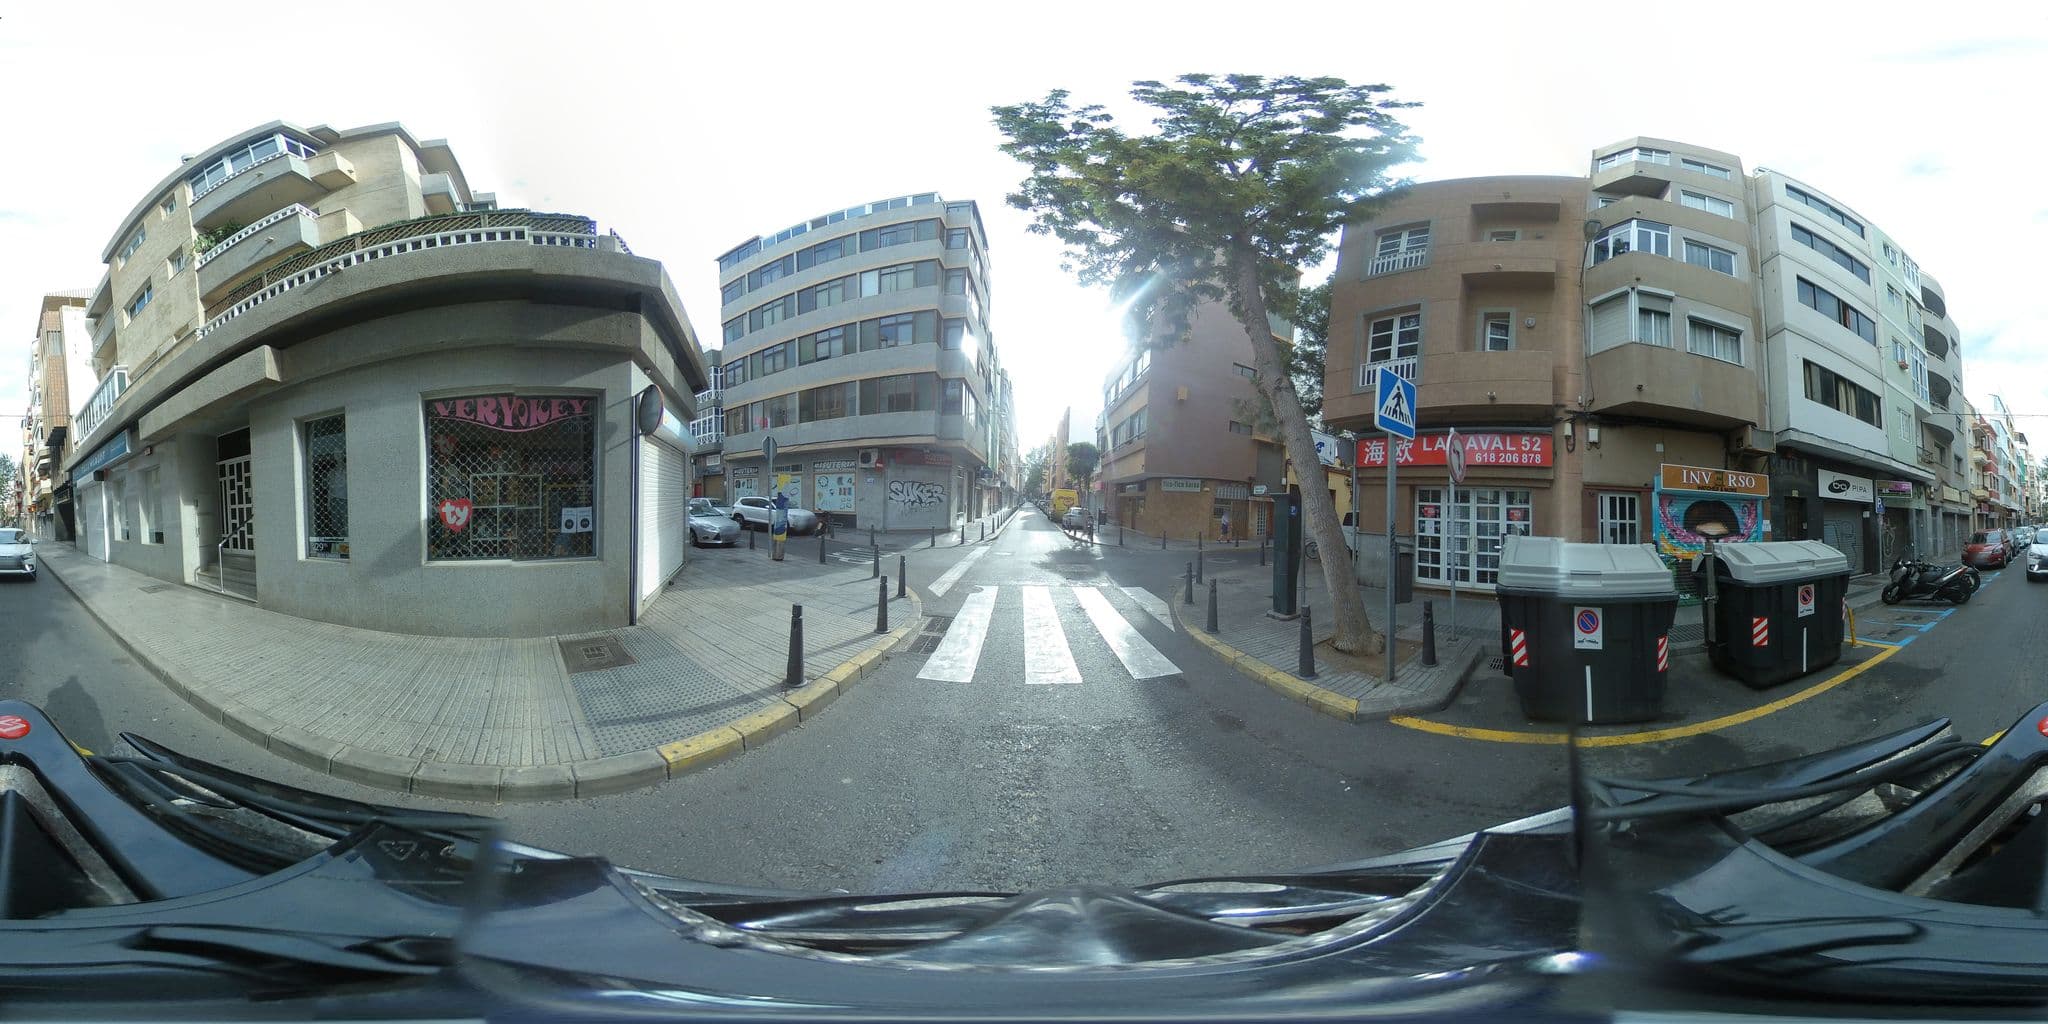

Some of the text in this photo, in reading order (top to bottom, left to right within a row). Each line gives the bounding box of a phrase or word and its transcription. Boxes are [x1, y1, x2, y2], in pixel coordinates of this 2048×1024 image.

[435, 397, 588, 427] VERYOKEY
[1423, 436, 1541, 451] LA AVAL 52
[1475, 452, 1541, 464] 618 206 878
[1682, 469, 1755, 489] INVRSO
[442, 502, 468, 525] ty
